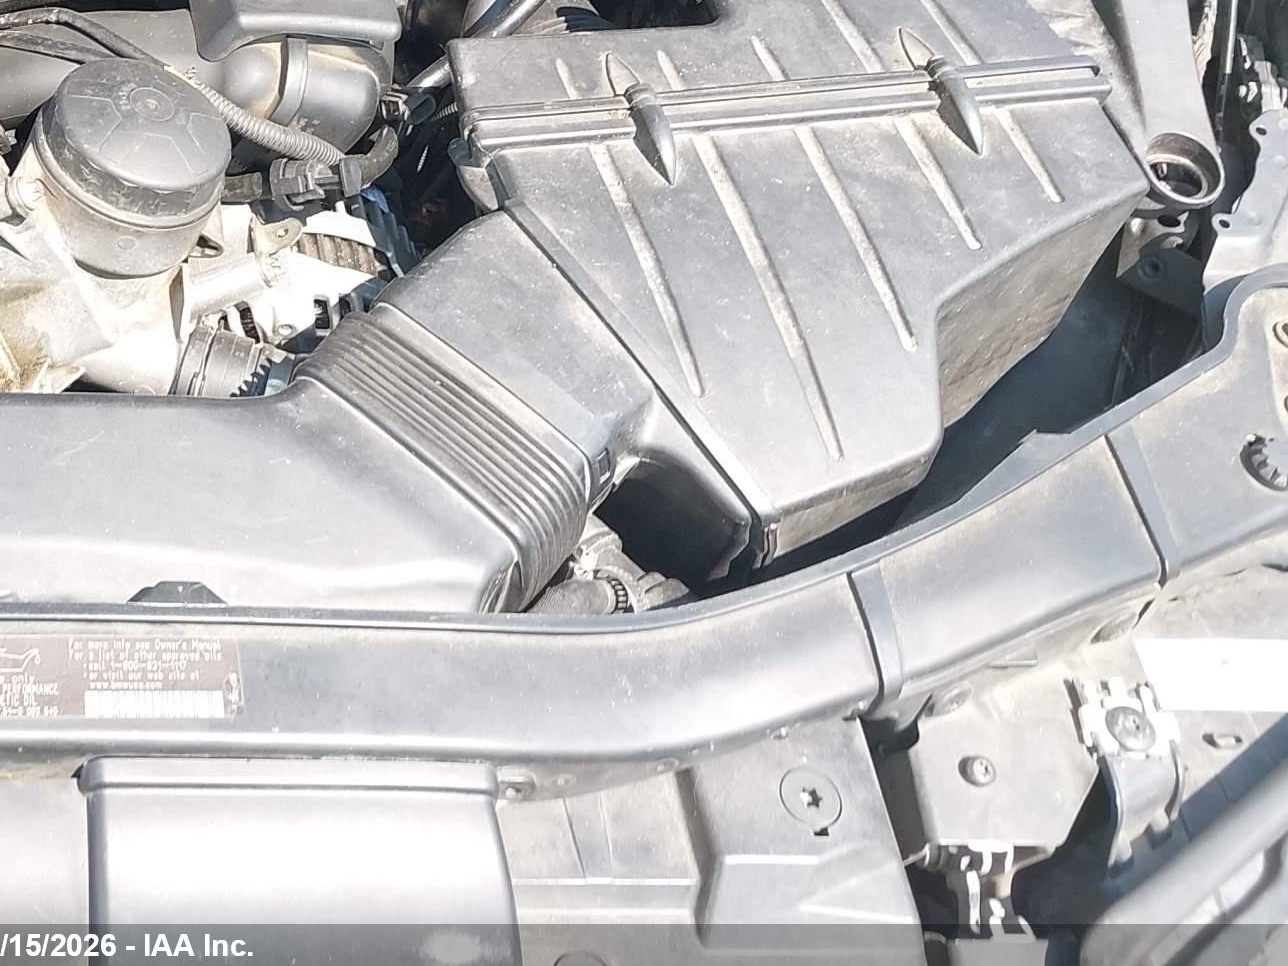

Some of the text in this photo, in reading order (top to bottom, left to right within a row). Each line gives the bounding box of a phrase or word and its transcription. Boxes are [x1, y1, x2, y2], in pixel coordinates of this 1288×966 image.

[68, 638, 82, 650] For
[88, 640, 109, 650] more
[154, 638, 187, 651] Owner's
[191, 638, 221, 651] Manual
[11, 671, 36, 686] only
[2, 682, 60, 696] PERFORMANCE
[23, 694, 39, 707] OIL
